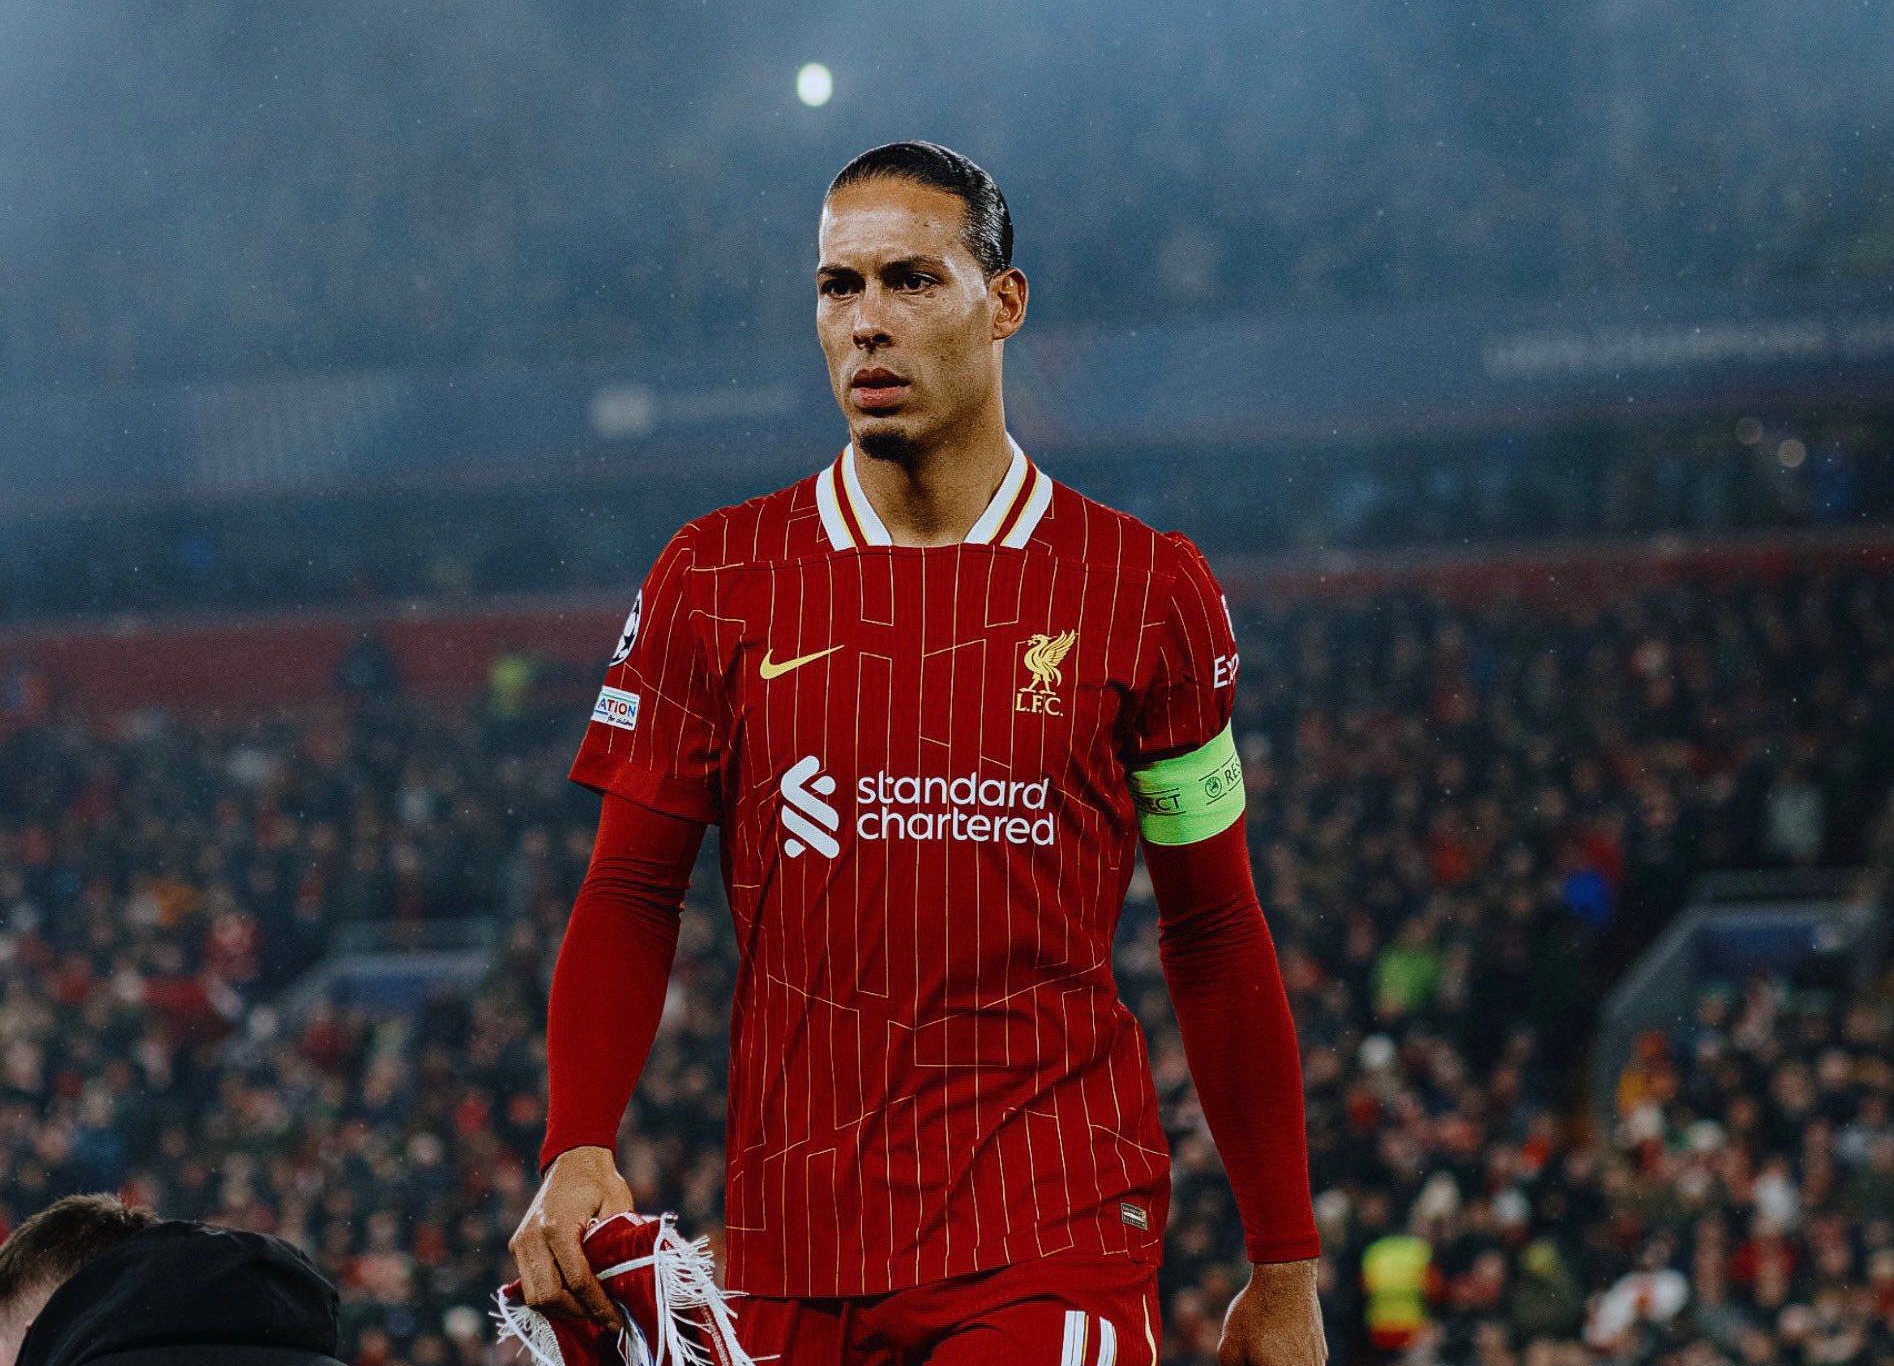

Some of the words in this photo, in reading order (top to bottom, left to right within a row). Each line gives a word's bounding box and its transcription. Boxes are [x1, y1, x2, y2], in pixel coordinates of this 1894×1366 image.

[597, 698, 637, 718] ATION
[1016, 693, 1064, 717] L.F.C.
[857, 770, 1050, 810] standard
[857, 806, 1055, 845] chartered
